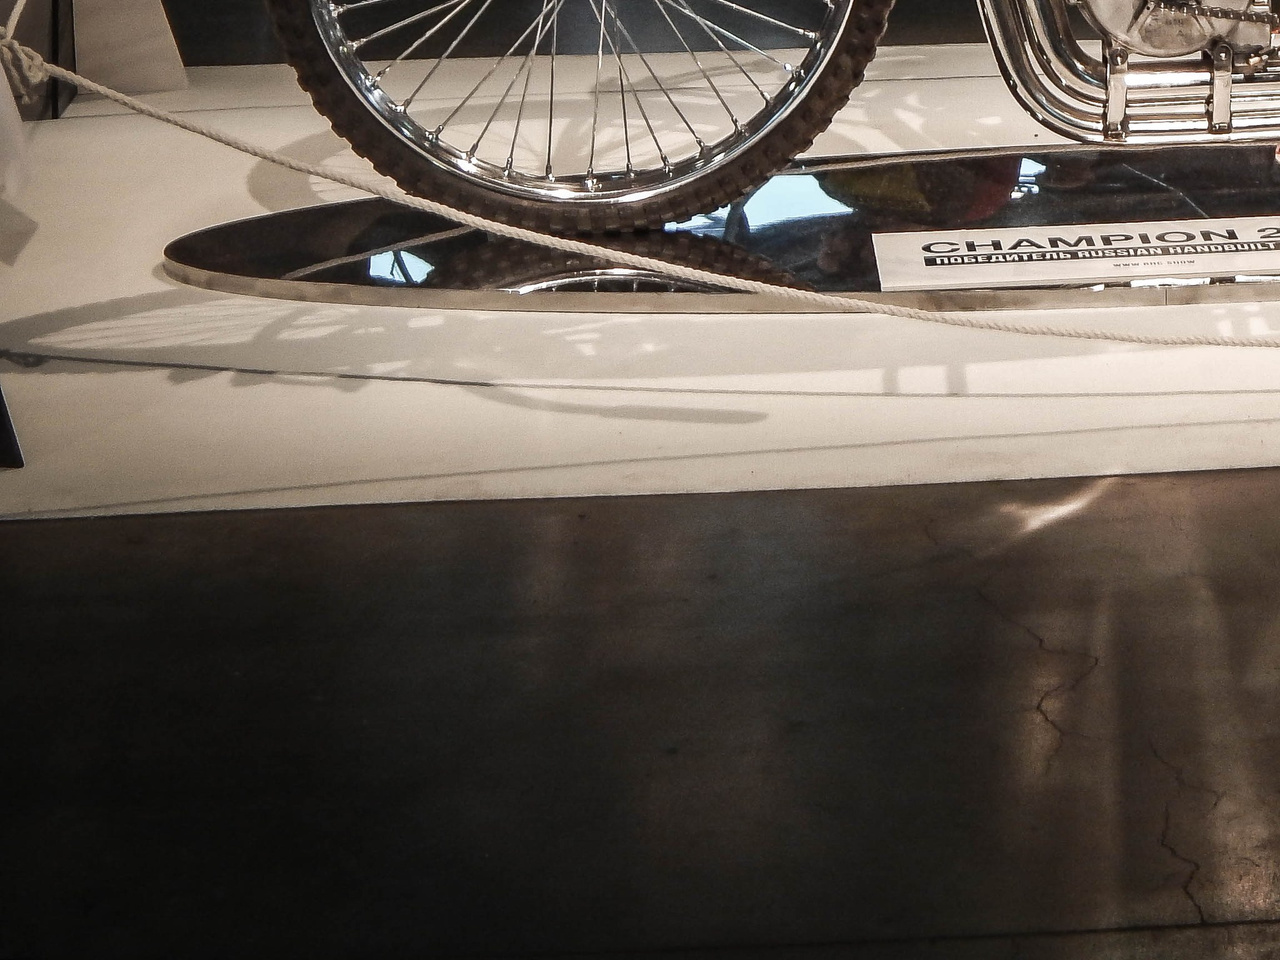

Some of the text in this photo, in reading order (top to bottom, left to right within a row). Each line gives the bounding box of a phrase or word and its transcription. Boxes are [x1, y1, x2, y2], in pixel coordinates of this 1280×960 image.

[921, 229, 1239, 254] CHAMPION
[935, 252, 1072, 265] ПОБЕДИТЕЛЬ
[1077, 247, 1163, 258] RUSSIAN
[1169, 241, 1279, 255] HANDBUILT
